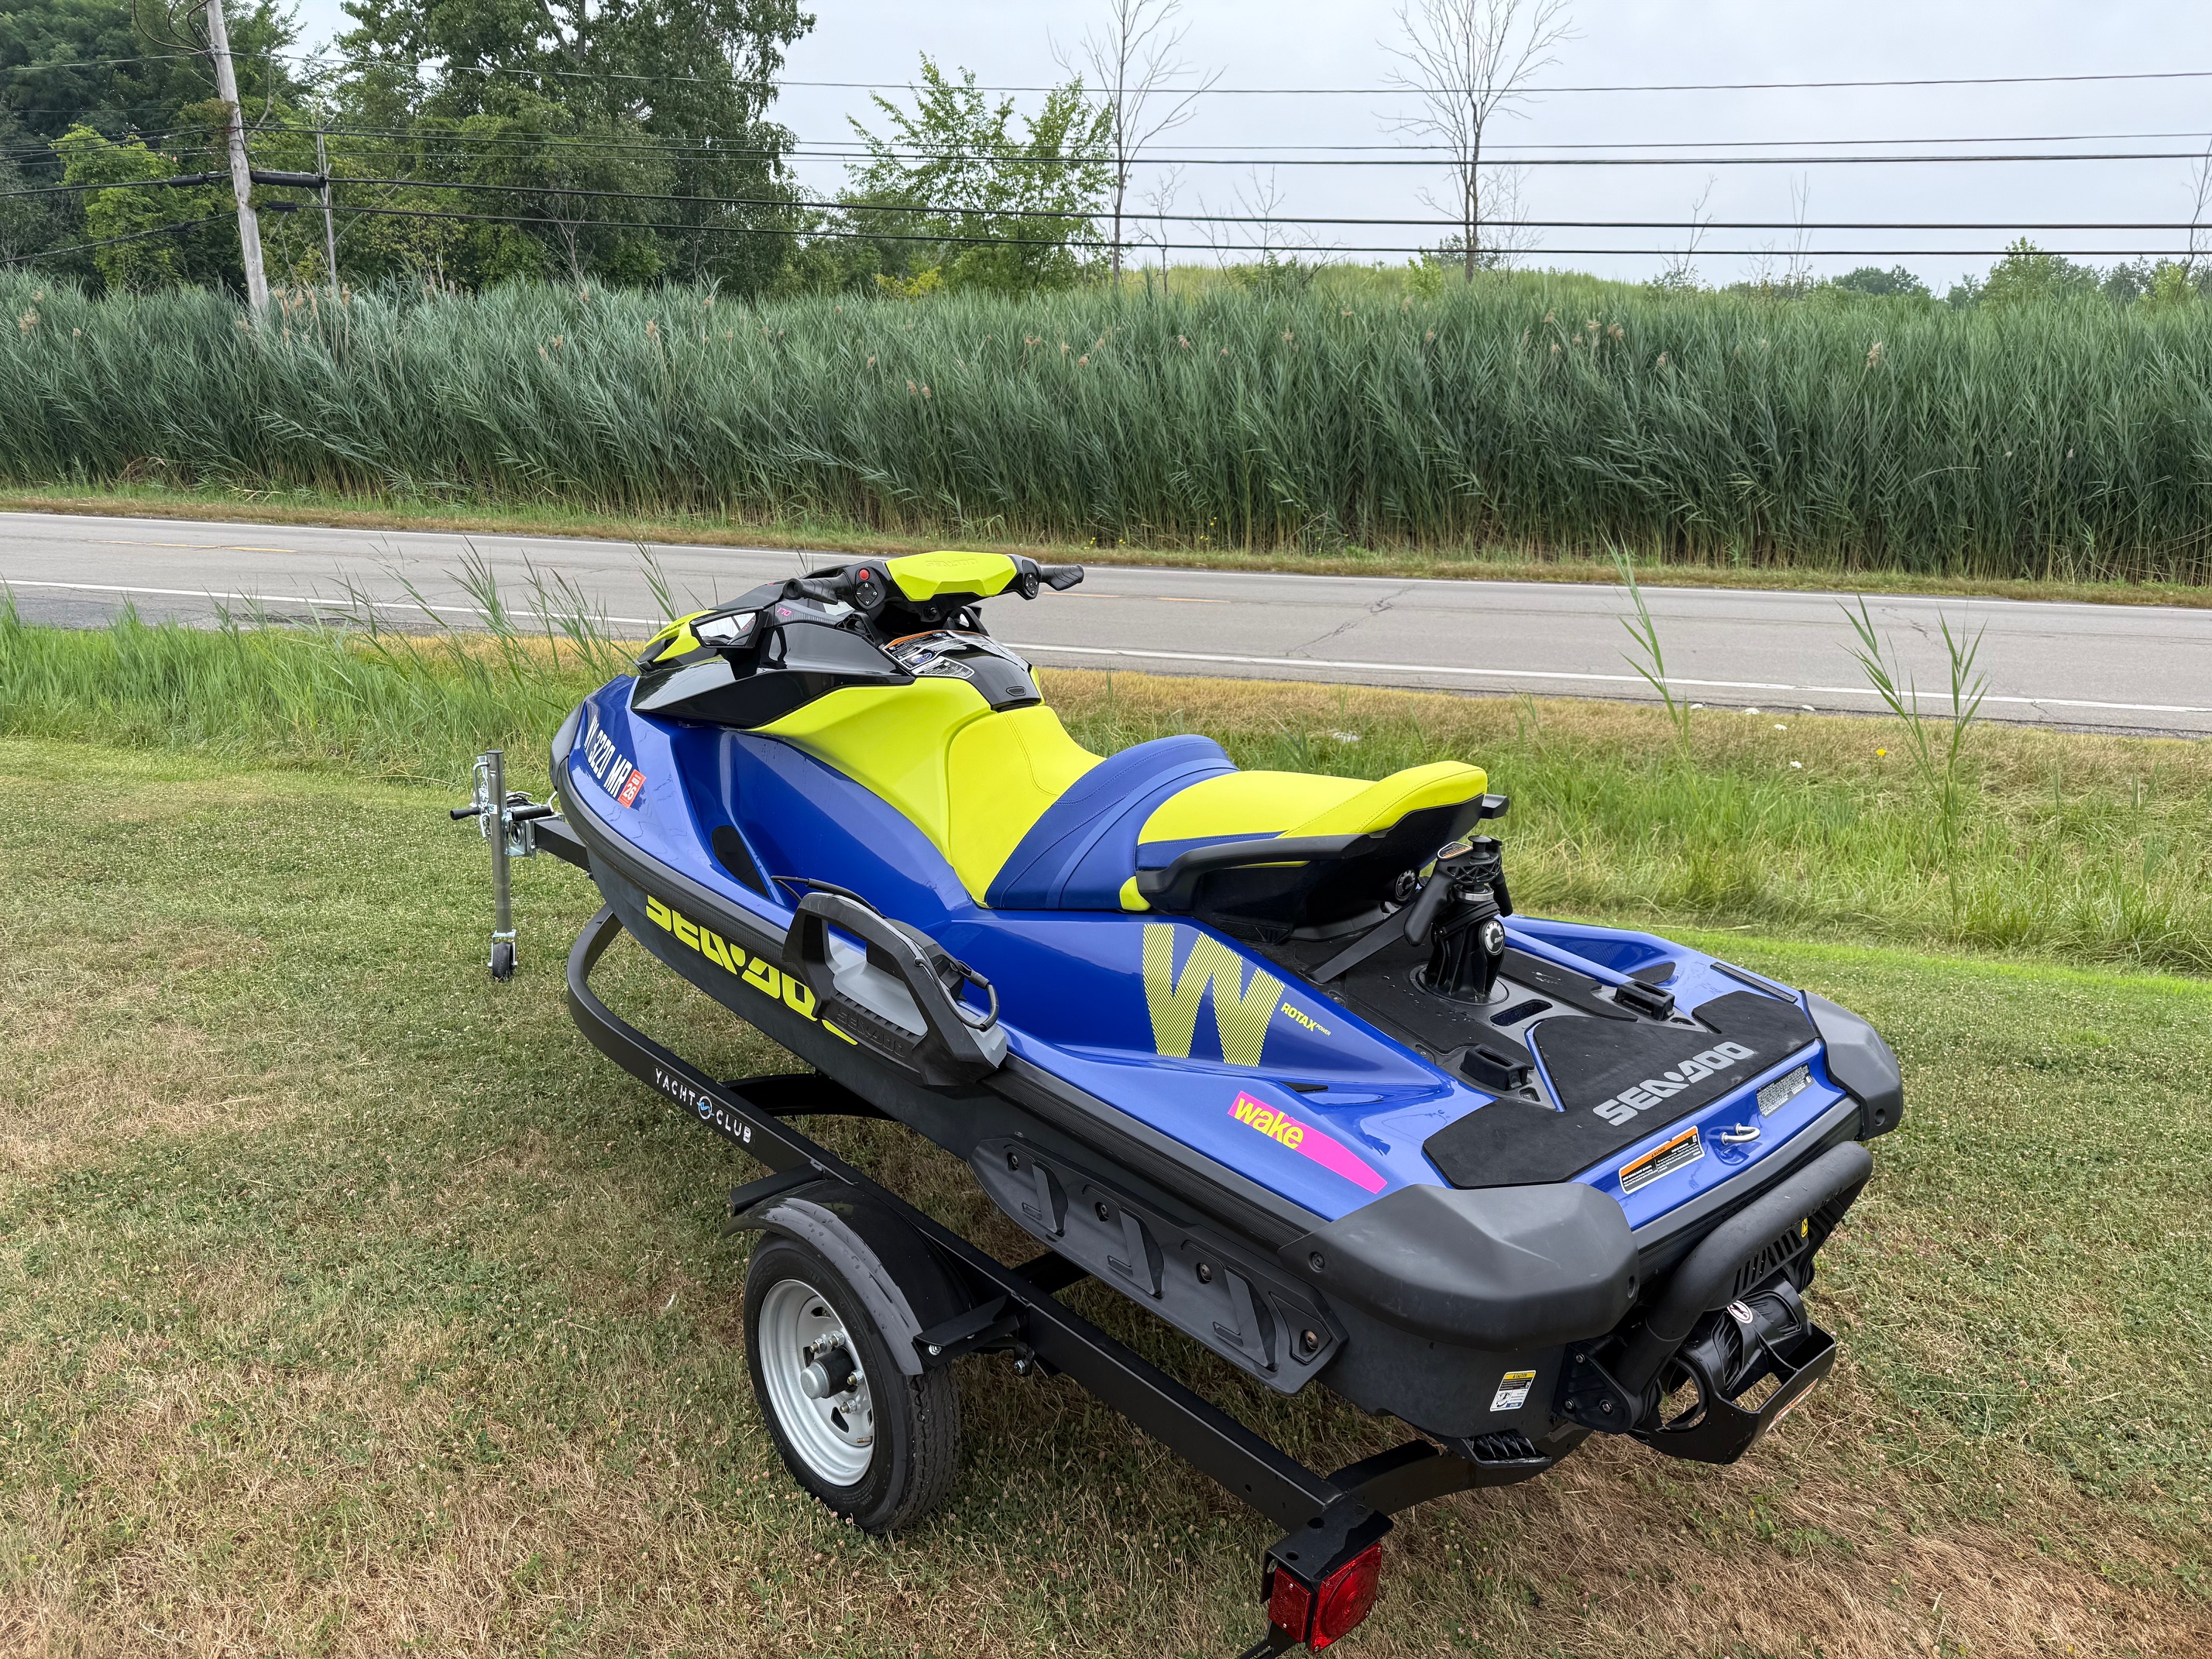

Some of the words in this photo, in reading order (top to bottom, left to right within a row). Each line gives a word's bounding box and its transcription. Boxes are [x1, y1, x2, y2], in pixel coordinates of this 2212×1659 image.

[588, 730, 617, 779] 3220
[603, 754, 633, 798] MR
[623, 782, 637, 801] 26
[1142, 923, 1285, 1068] W
[1280, 1001, 1317, 1032] ROTAX
[1315, 1023, 1331, 1036] POWER
[655, 1067, 696, 1106] YACHT
[716, 1109, 751, 1143] CLUB
[1232, 1097, 1304, 1150] wake
